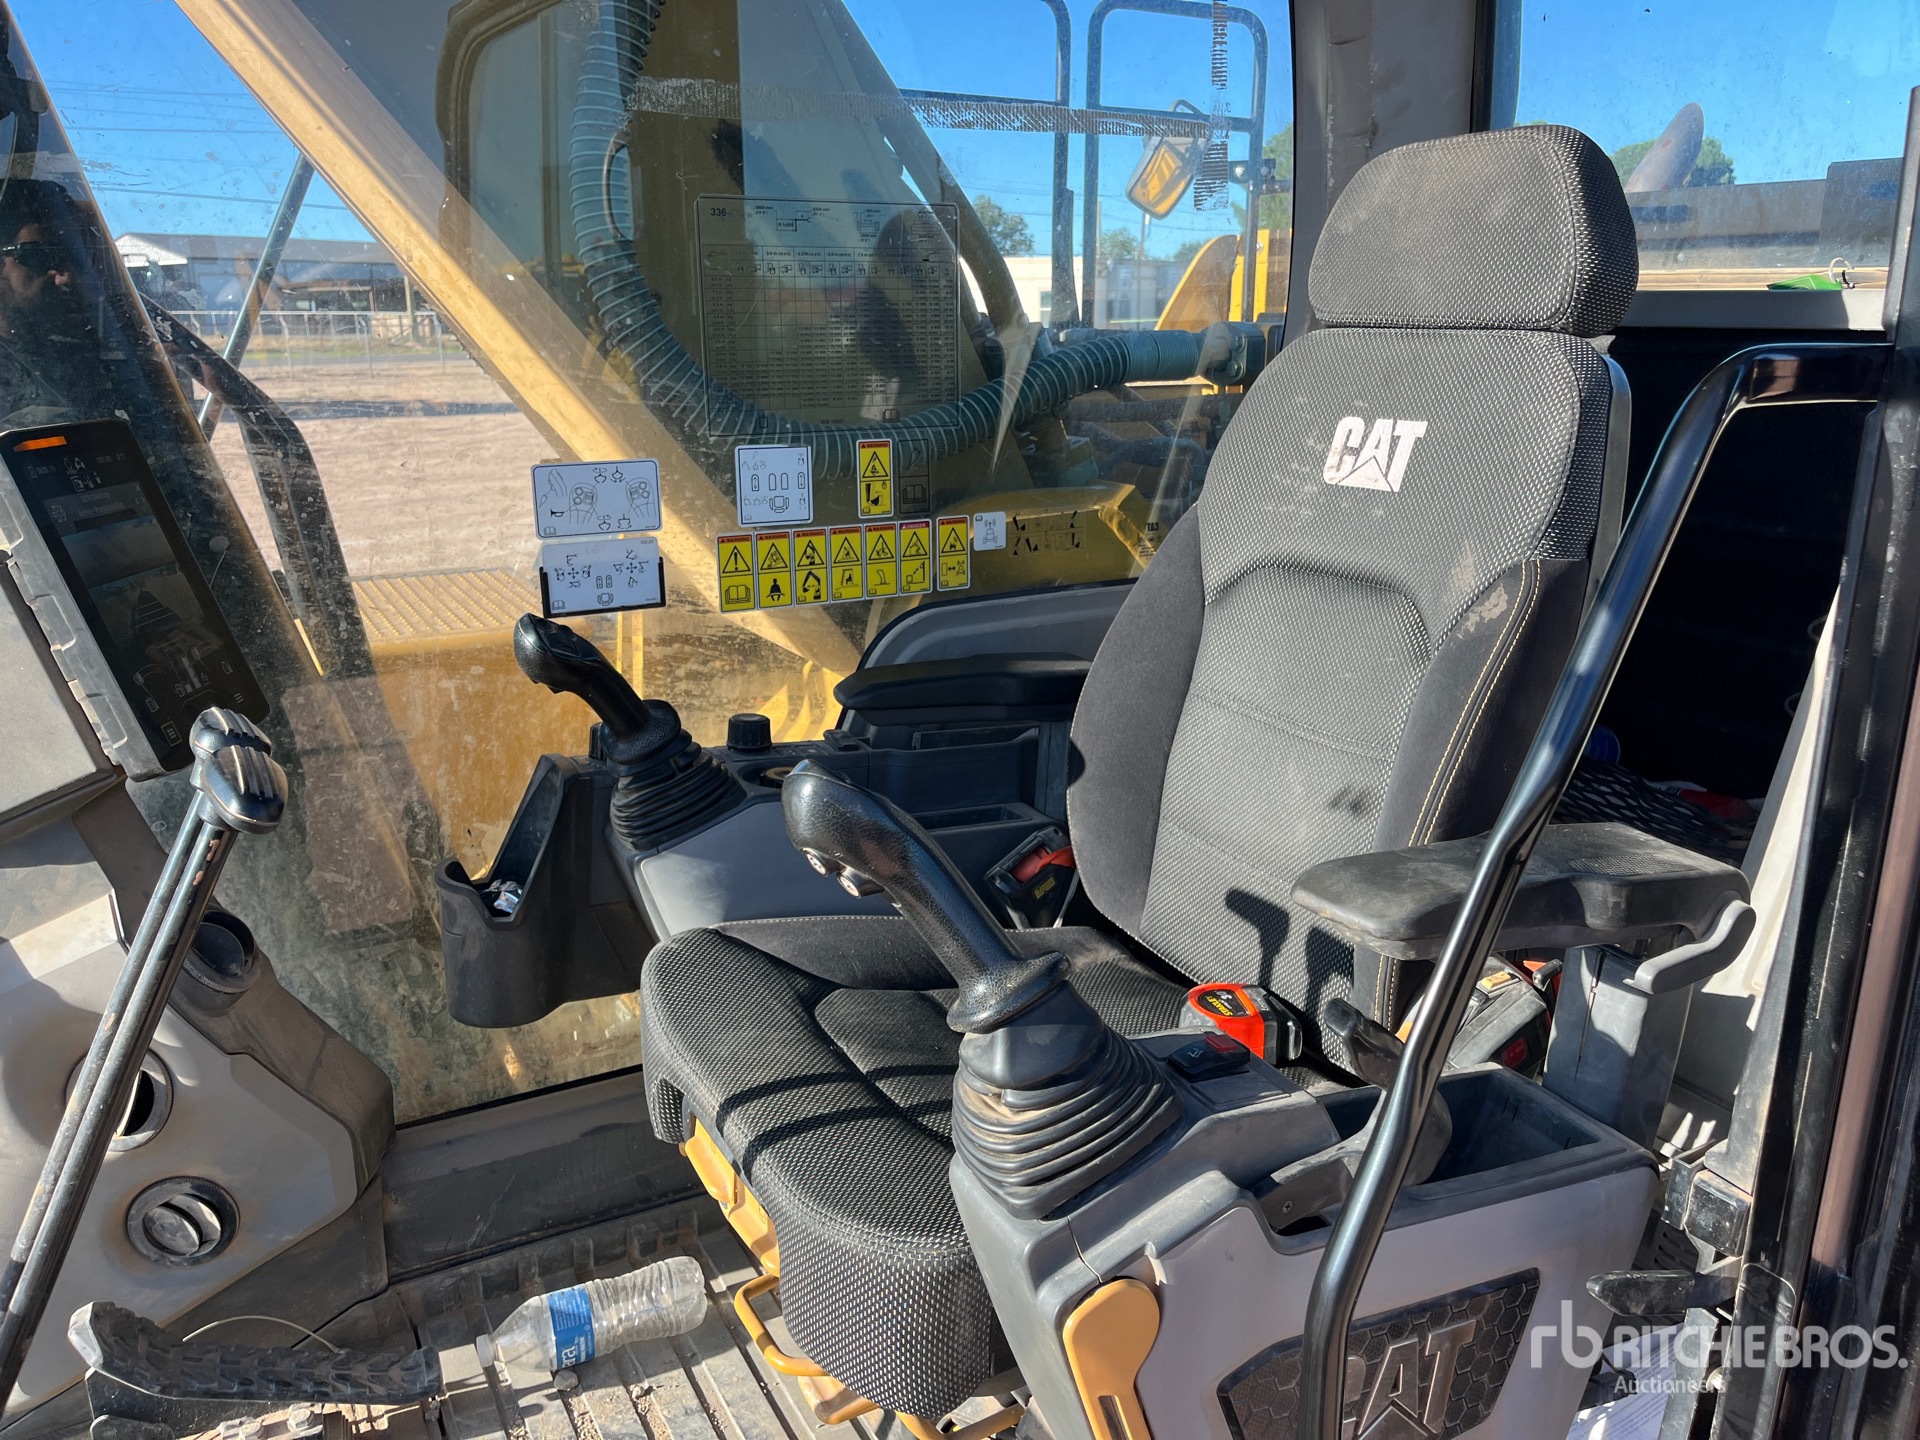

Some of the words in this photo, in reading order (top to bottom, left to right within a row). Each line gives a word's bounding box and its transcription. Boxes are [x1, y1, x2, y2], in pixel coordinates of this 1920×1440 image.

[710, 207, 727, 217] 336
[1323, 416, 1428, 492] CAT
[801, 530, 825, 538] WARNING
[838, 527, 860, 535] WARNING
[764, 533, 788, 541] WARNING
[1204, 995, 1234, 1016] STANLEY
